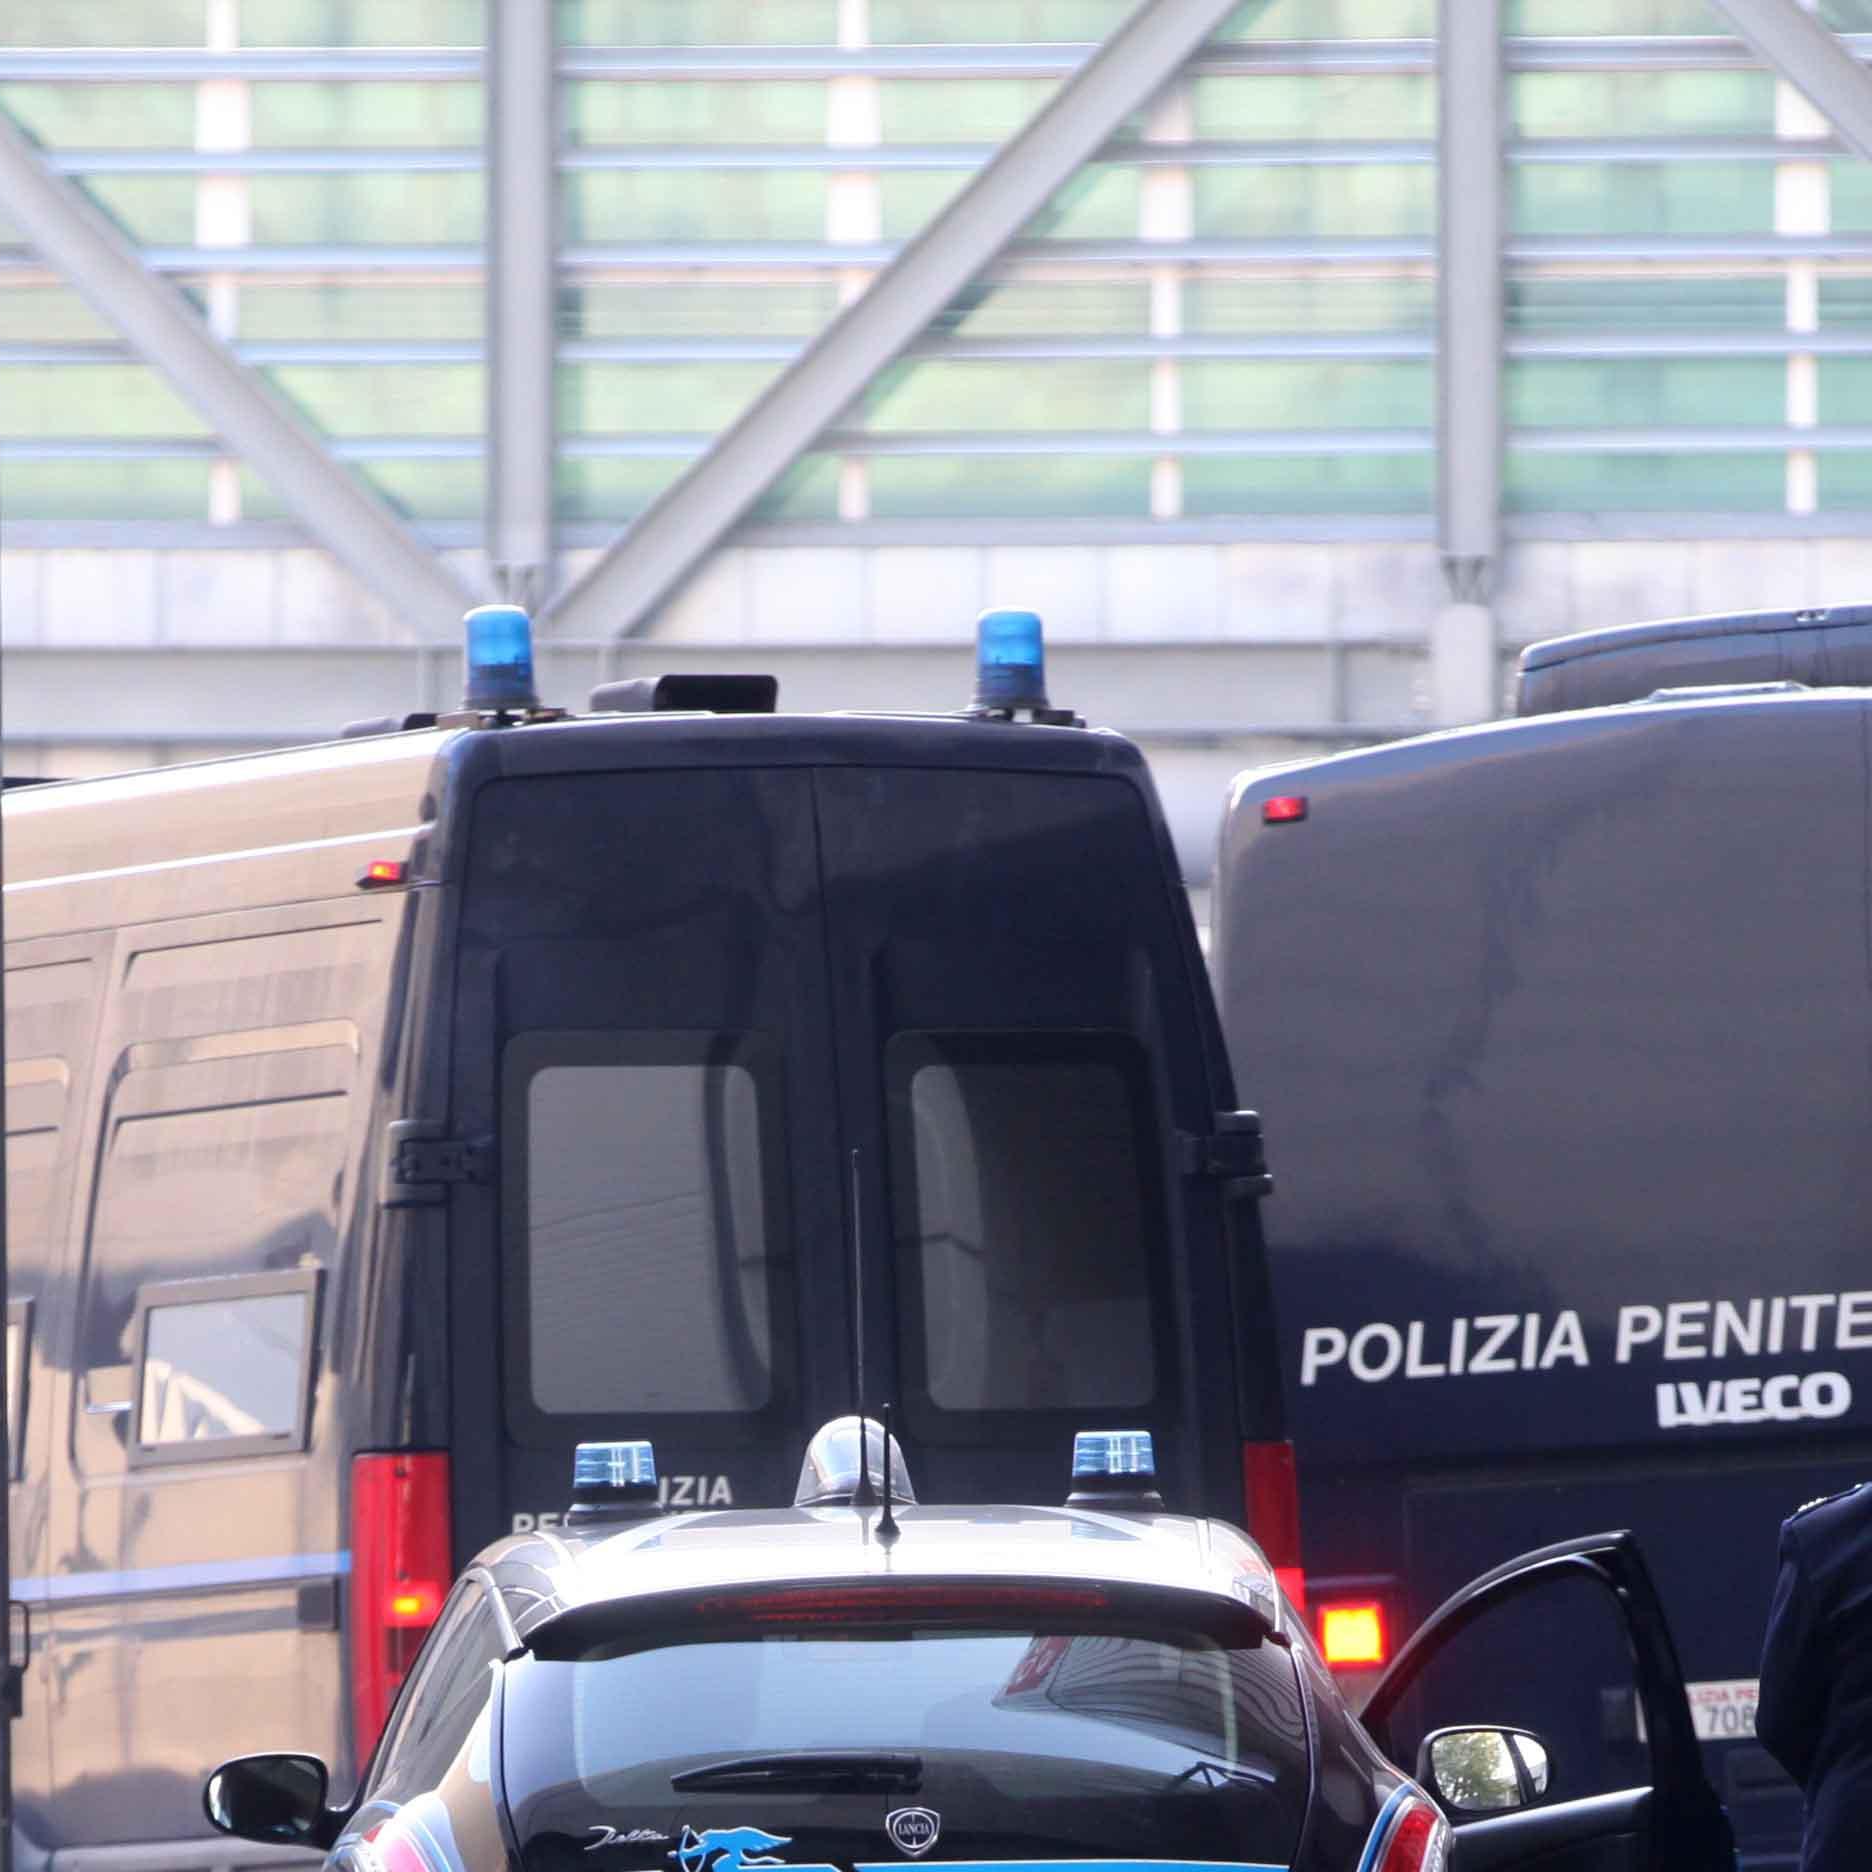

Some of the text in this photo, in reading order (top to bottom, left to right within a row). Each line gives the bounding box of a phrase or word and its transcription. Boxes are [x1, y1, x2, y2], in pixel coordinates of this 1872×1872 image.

[1300, 1310, 1589, 1386] POLIZIA
[1656, 1371, 1853, 1428] IVECO
[658, 1475, 734, 1505] IZIA
